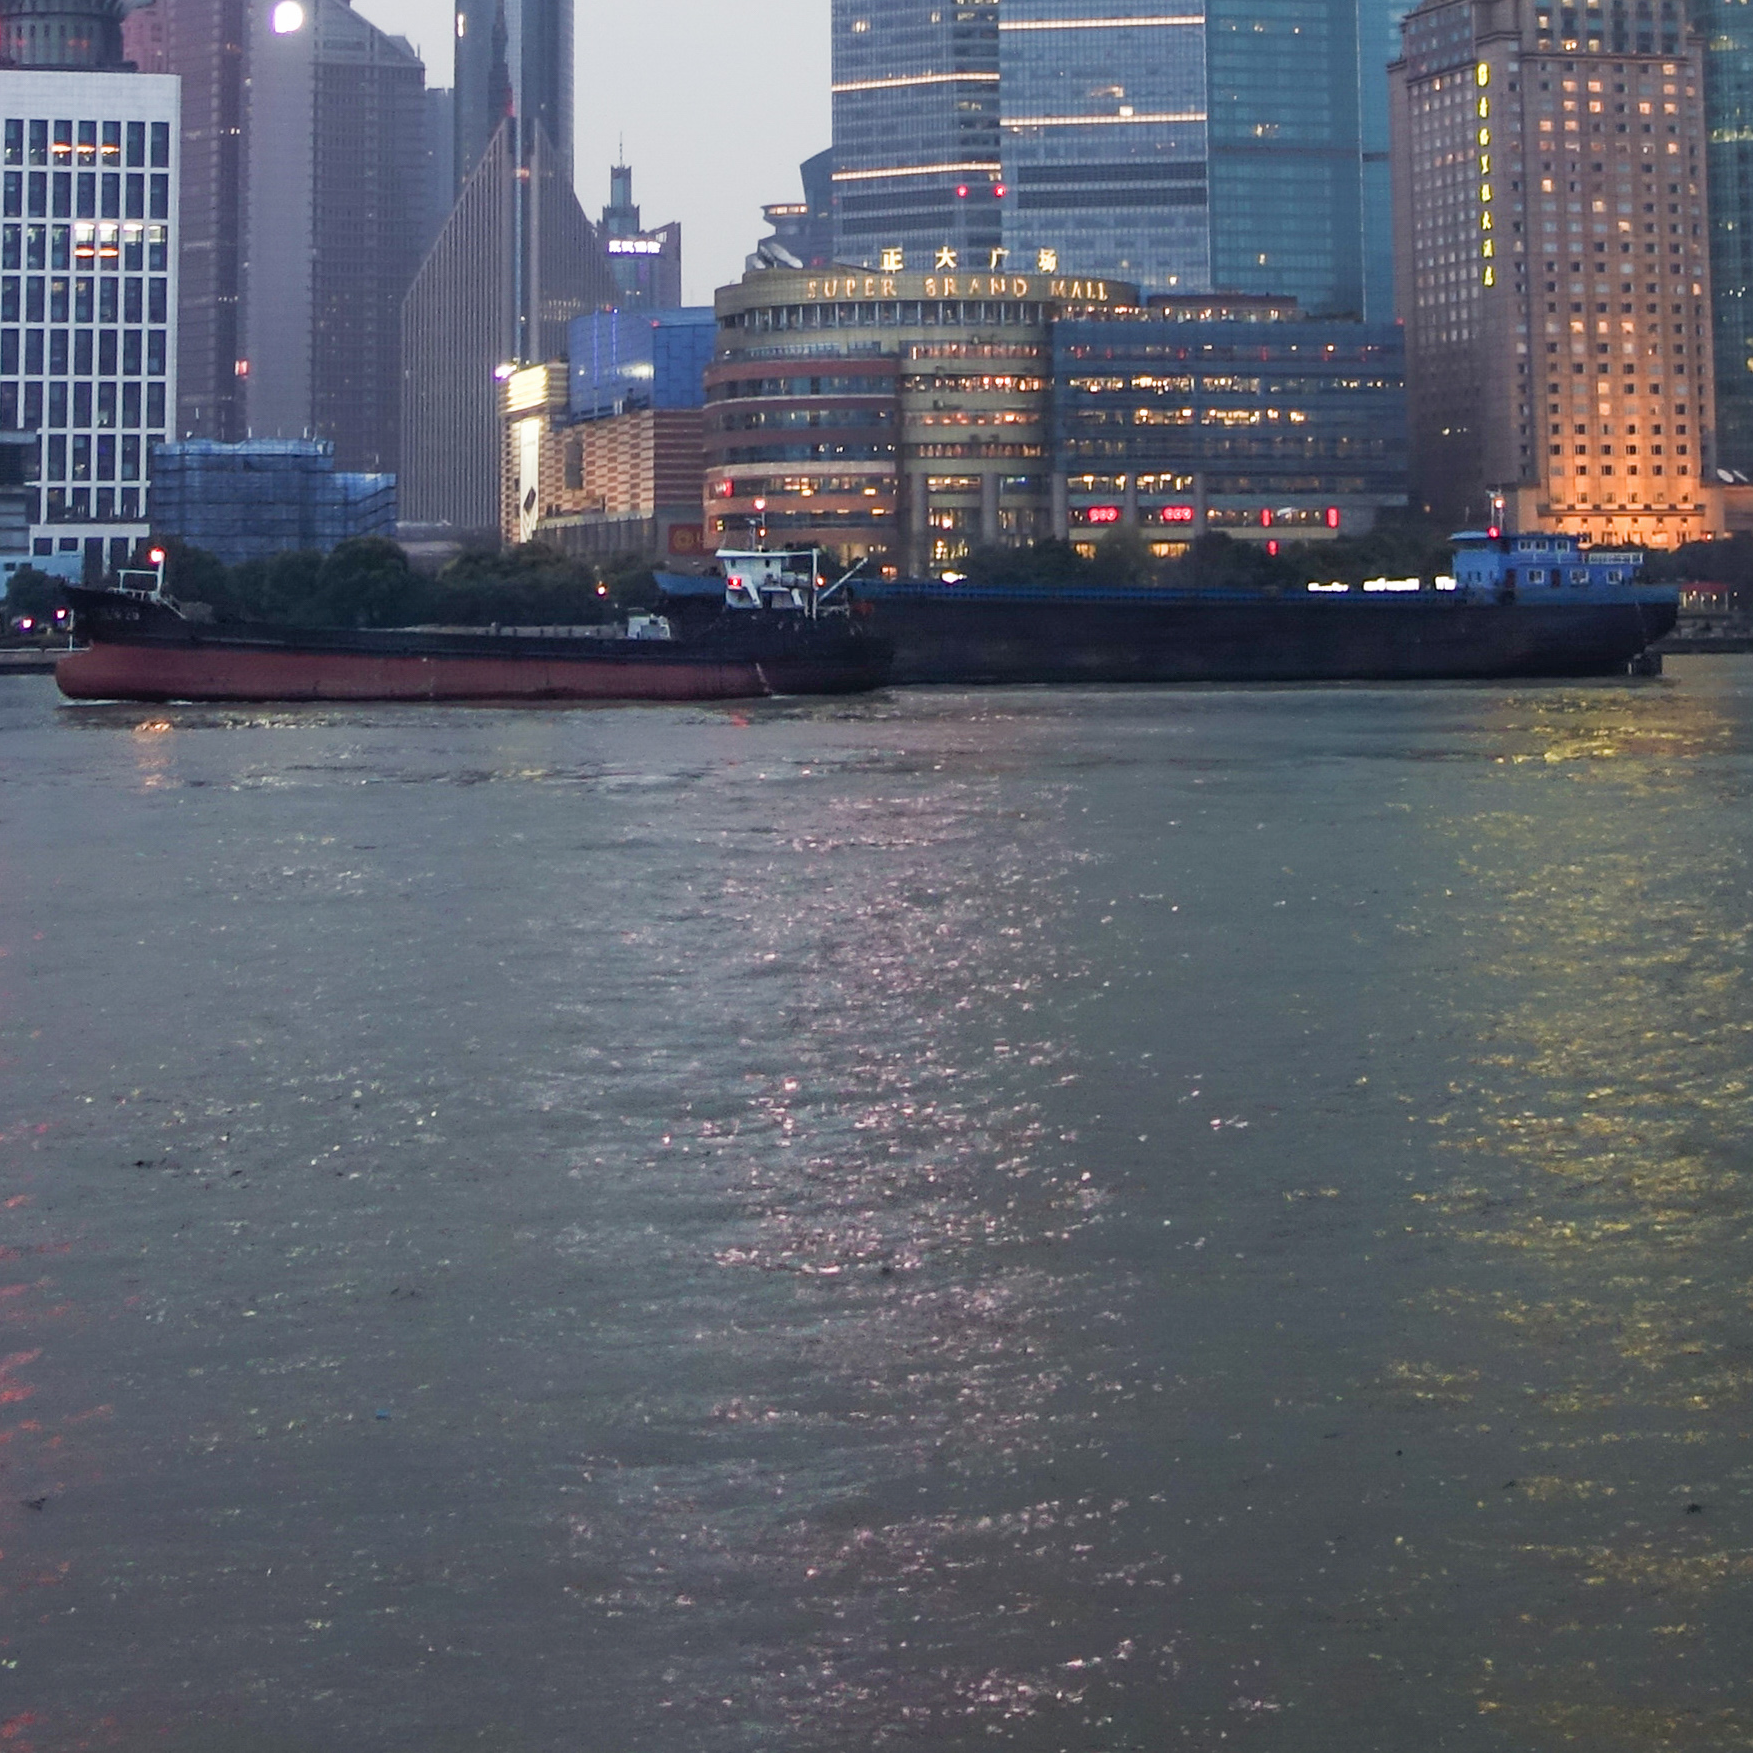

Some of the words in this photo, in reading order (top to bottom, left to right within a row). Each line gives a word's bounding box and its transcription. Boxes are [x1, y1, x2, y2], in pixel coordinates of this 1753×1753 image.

[881, 246, 1058, 273] 正大广场
[807, 277, 897, 298] SUPER
[925, 277, 1028, 298] GRAND
[1050, 280, 1109, 301] MALL
